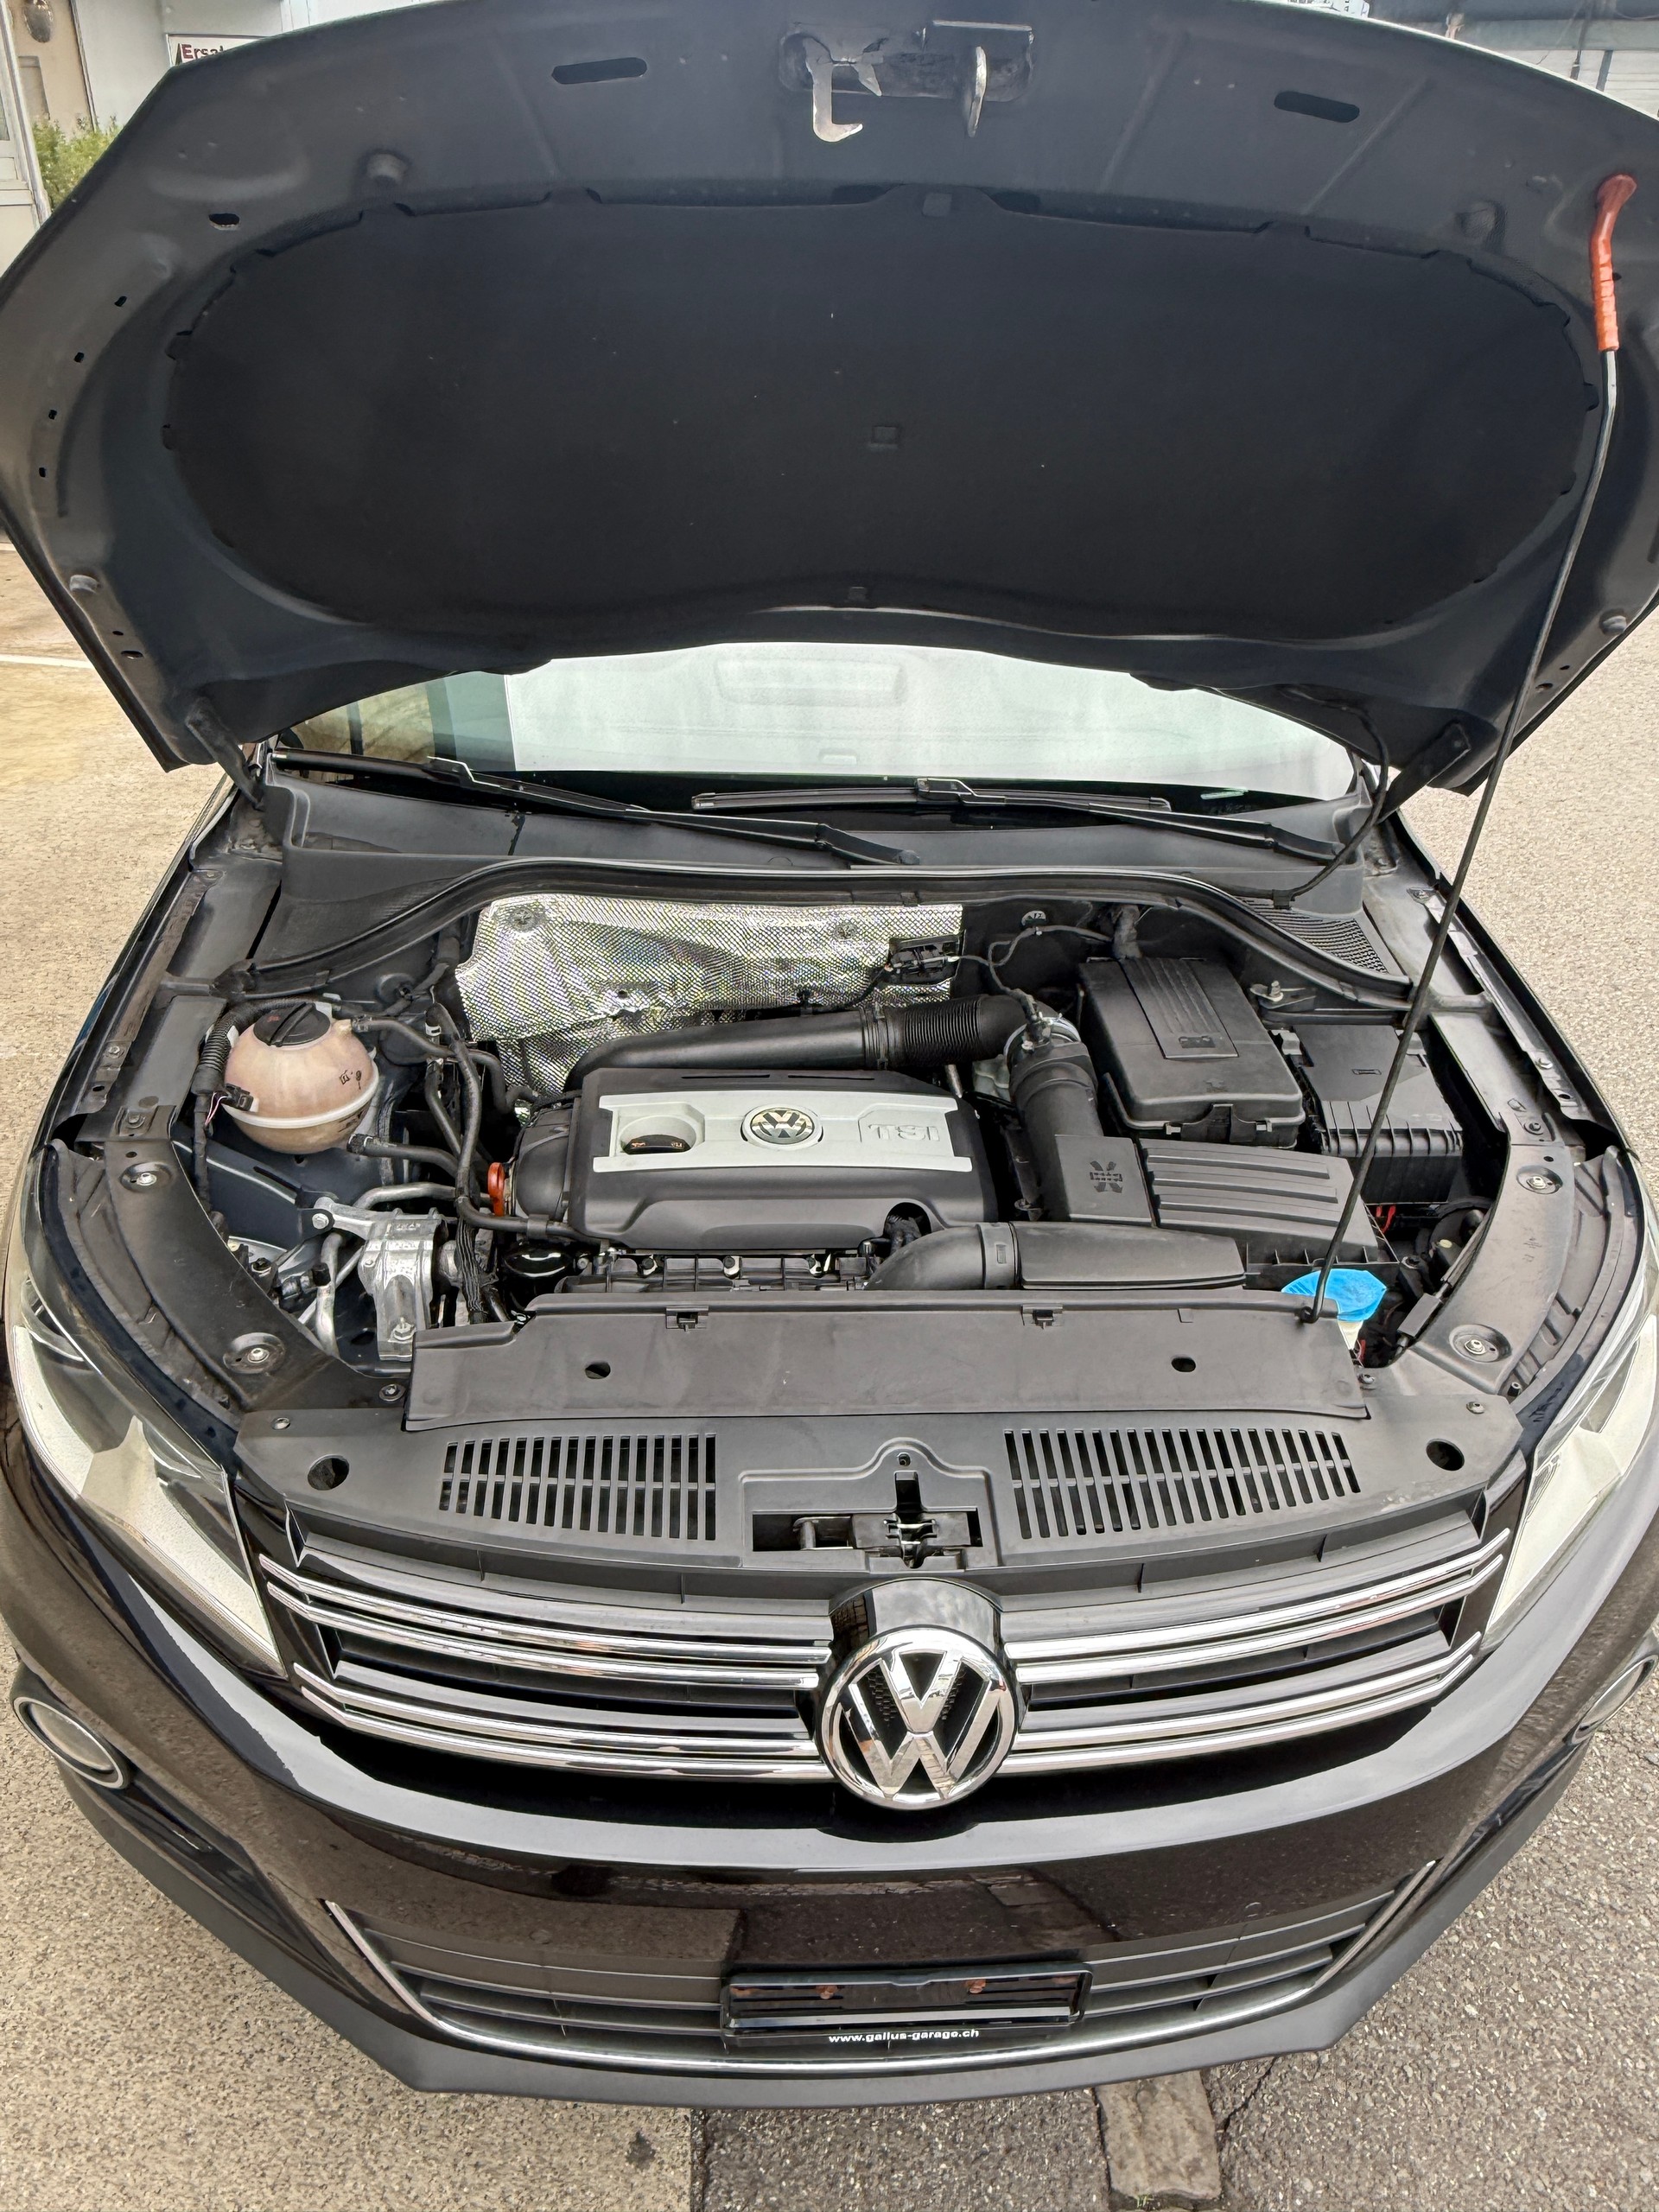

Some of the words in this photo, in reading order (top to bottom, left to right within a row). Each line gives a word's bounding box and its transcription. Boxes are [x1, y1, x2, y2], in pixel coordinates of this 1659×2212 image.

[752, 1109, 814, 1144] VW
[868, 1123, 940, 1141] TSI
[830, 1636, 1011, 1804] VW
[828, 2029, 980, 2044] www.gallus-garage.ch
